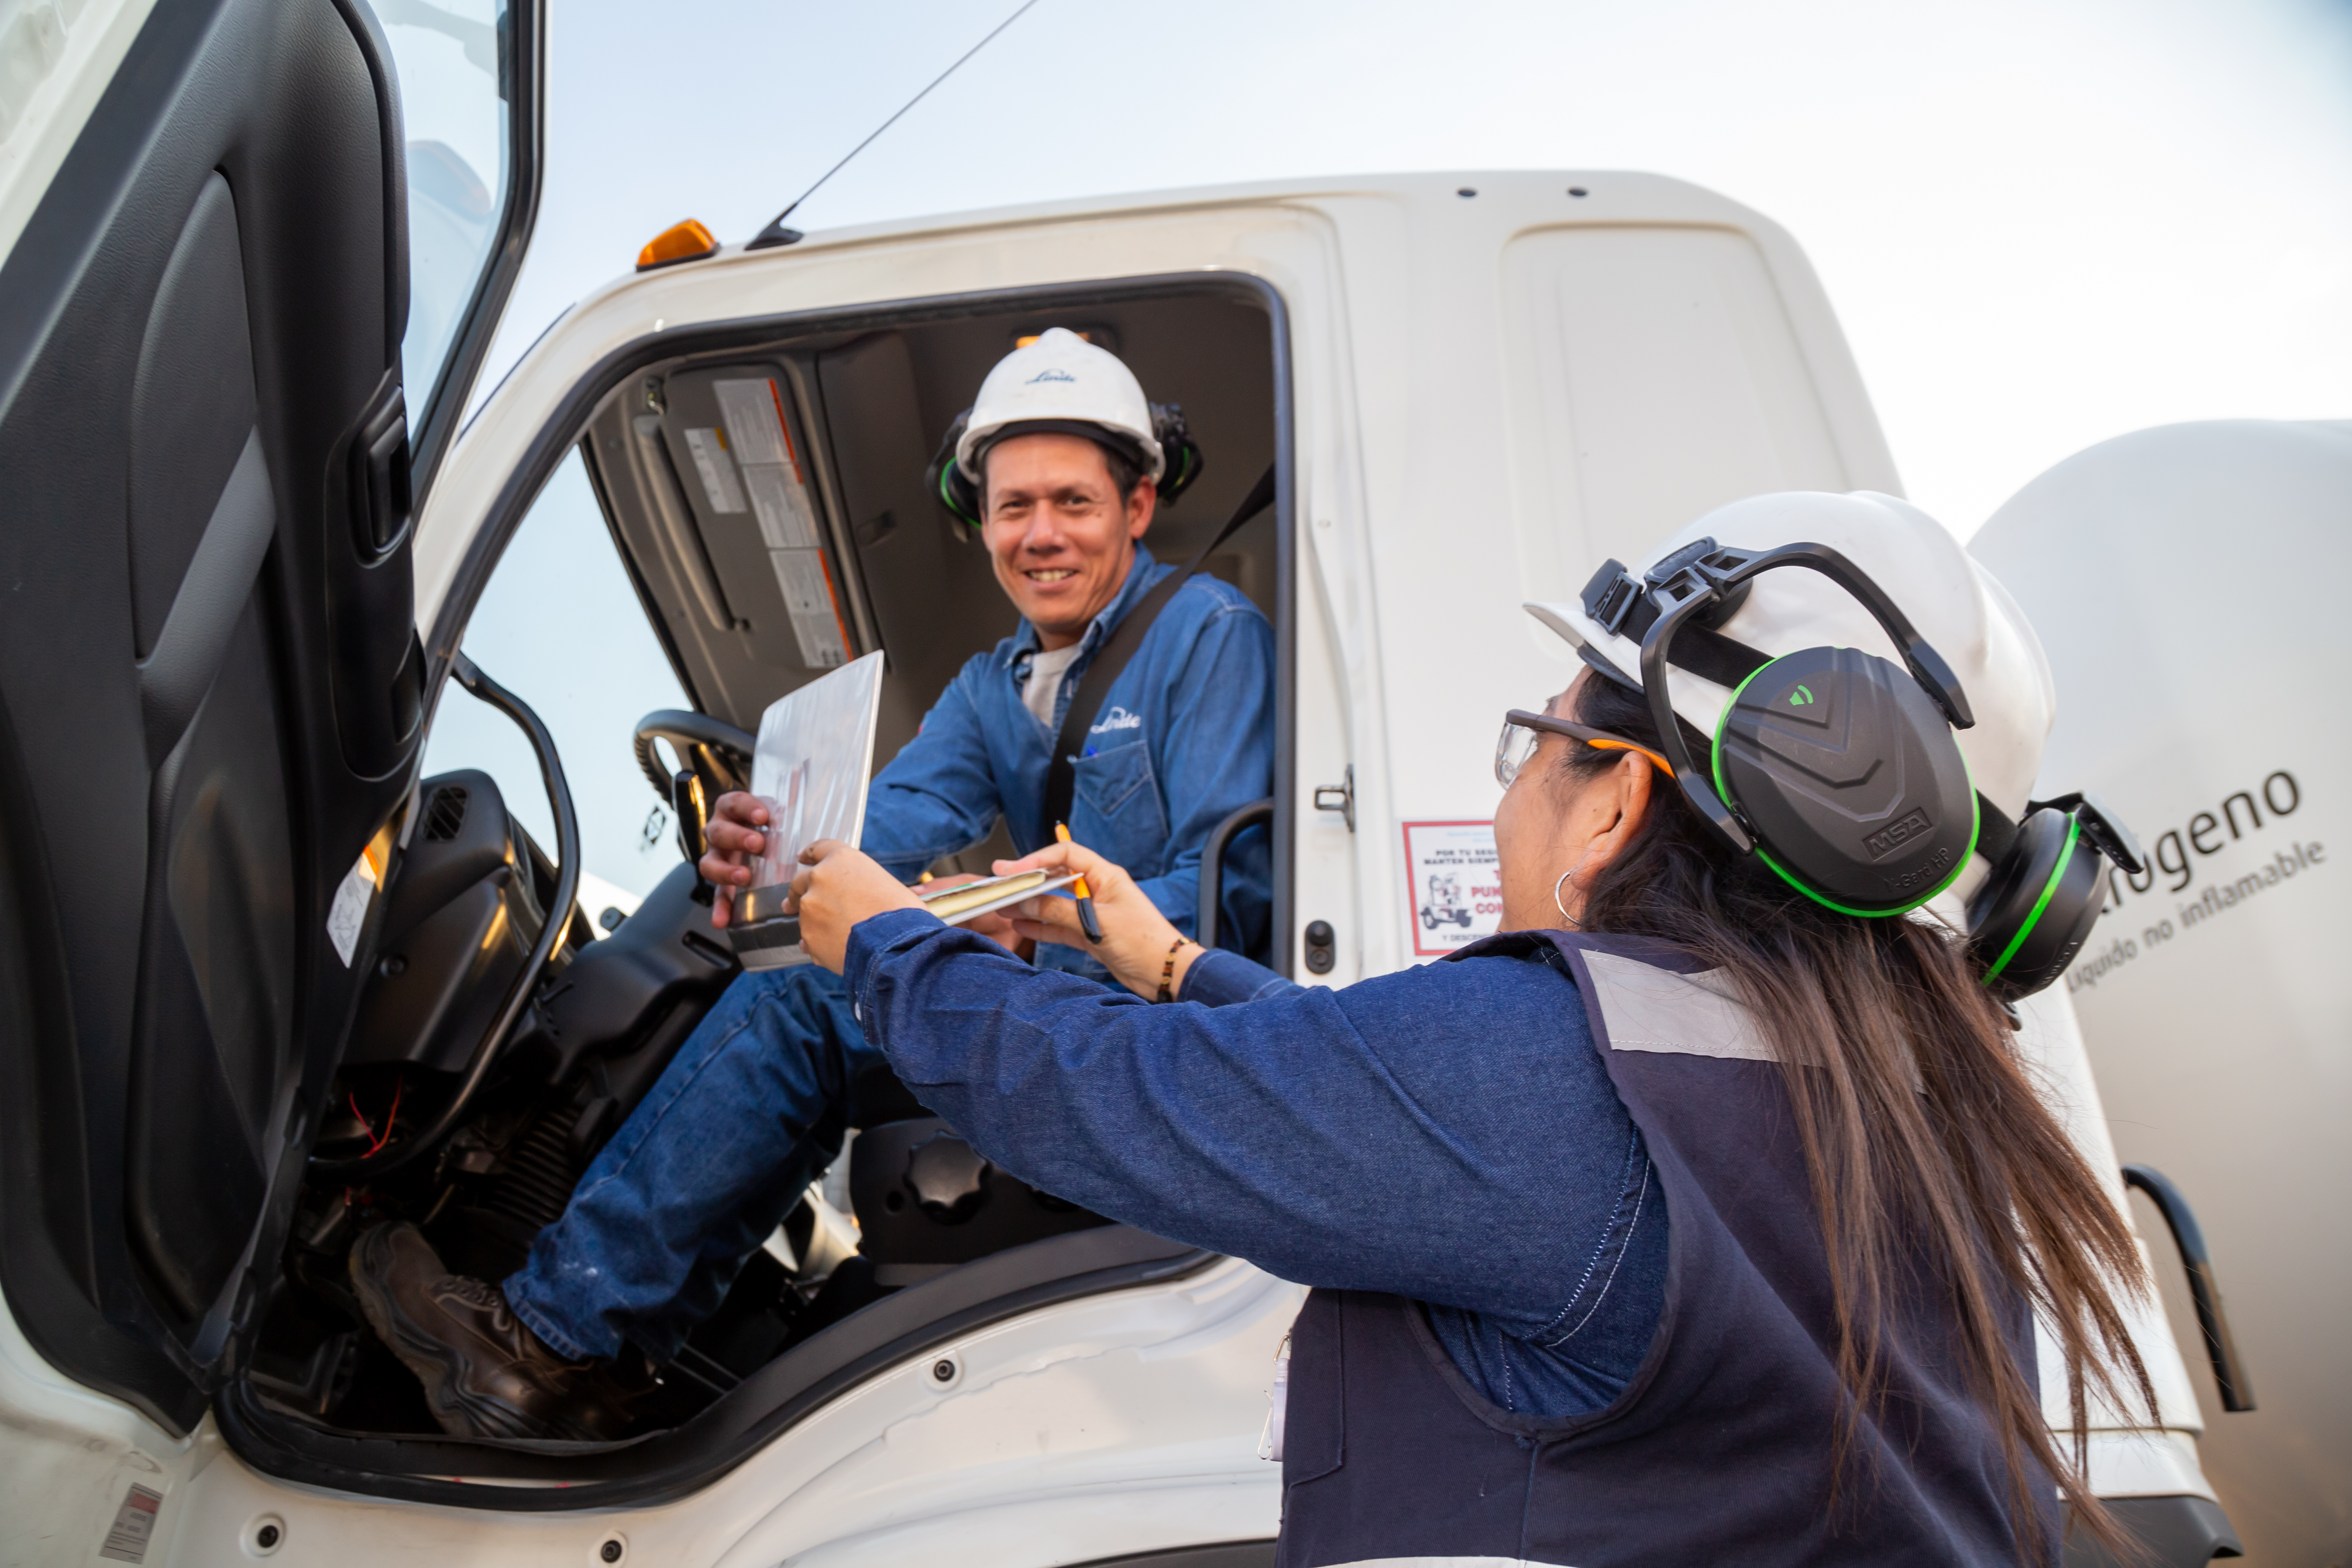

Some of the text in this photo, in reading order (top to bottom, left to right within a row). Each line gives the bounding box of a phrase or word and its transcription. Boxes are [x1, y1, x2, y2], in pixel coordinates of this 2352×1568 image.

[1868, 814, 1929, 857] MSA
[1931, 848, 1950, 869] HP
[2101, 769, 2301, 914] rogeno
[2142, 919, 2174, 949] no
[2176, 841, 2326, 928] inflamable
